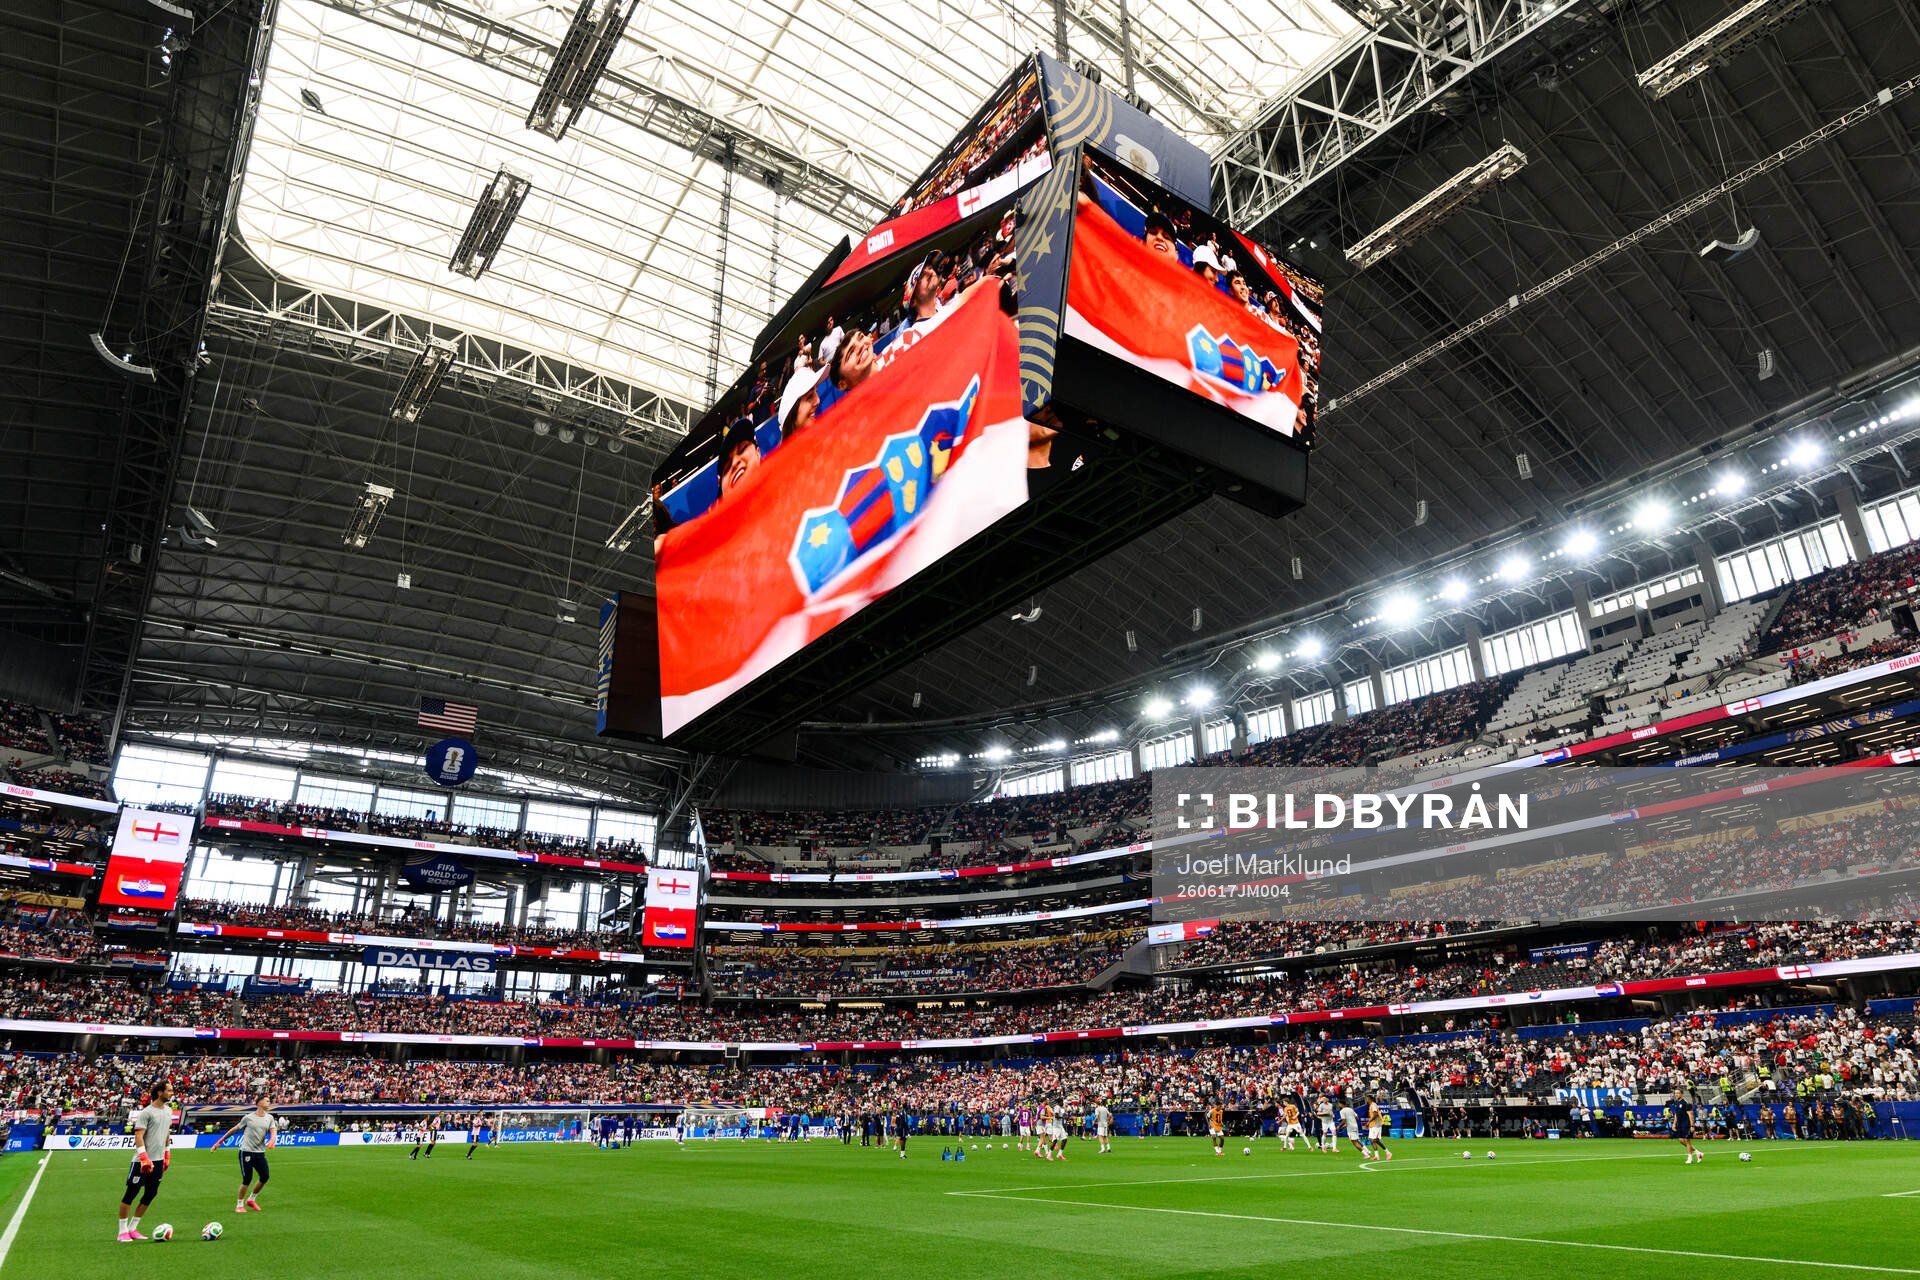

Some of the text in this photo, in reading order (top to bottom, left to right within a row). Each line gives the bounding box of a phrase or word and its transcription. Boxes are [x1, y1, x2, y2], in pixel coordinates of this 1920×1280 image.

[867, 228, 895, 255] CROATIA
[1889, 655, 1920, 670] ENGLAN
[1632, 727, 1658, 740] CROATIA
[1675, 752, 1720, 767] #FIFAWorldCup
[7, 785, 34, 797] ENGLAND
[1742, 783, 1769, 796] CROATIA
[420, 868, 451, 879] WORLD
[437, 863, 455, 872] FIFA
[376, 951, 491, 971] DALLAS
[276, 1134, 296, 1145] EACE
[639, 1129, 654, 1138] EACE
[82, 1136, 106, 1148] Unite
[107, 1136, 121, 1148] For
